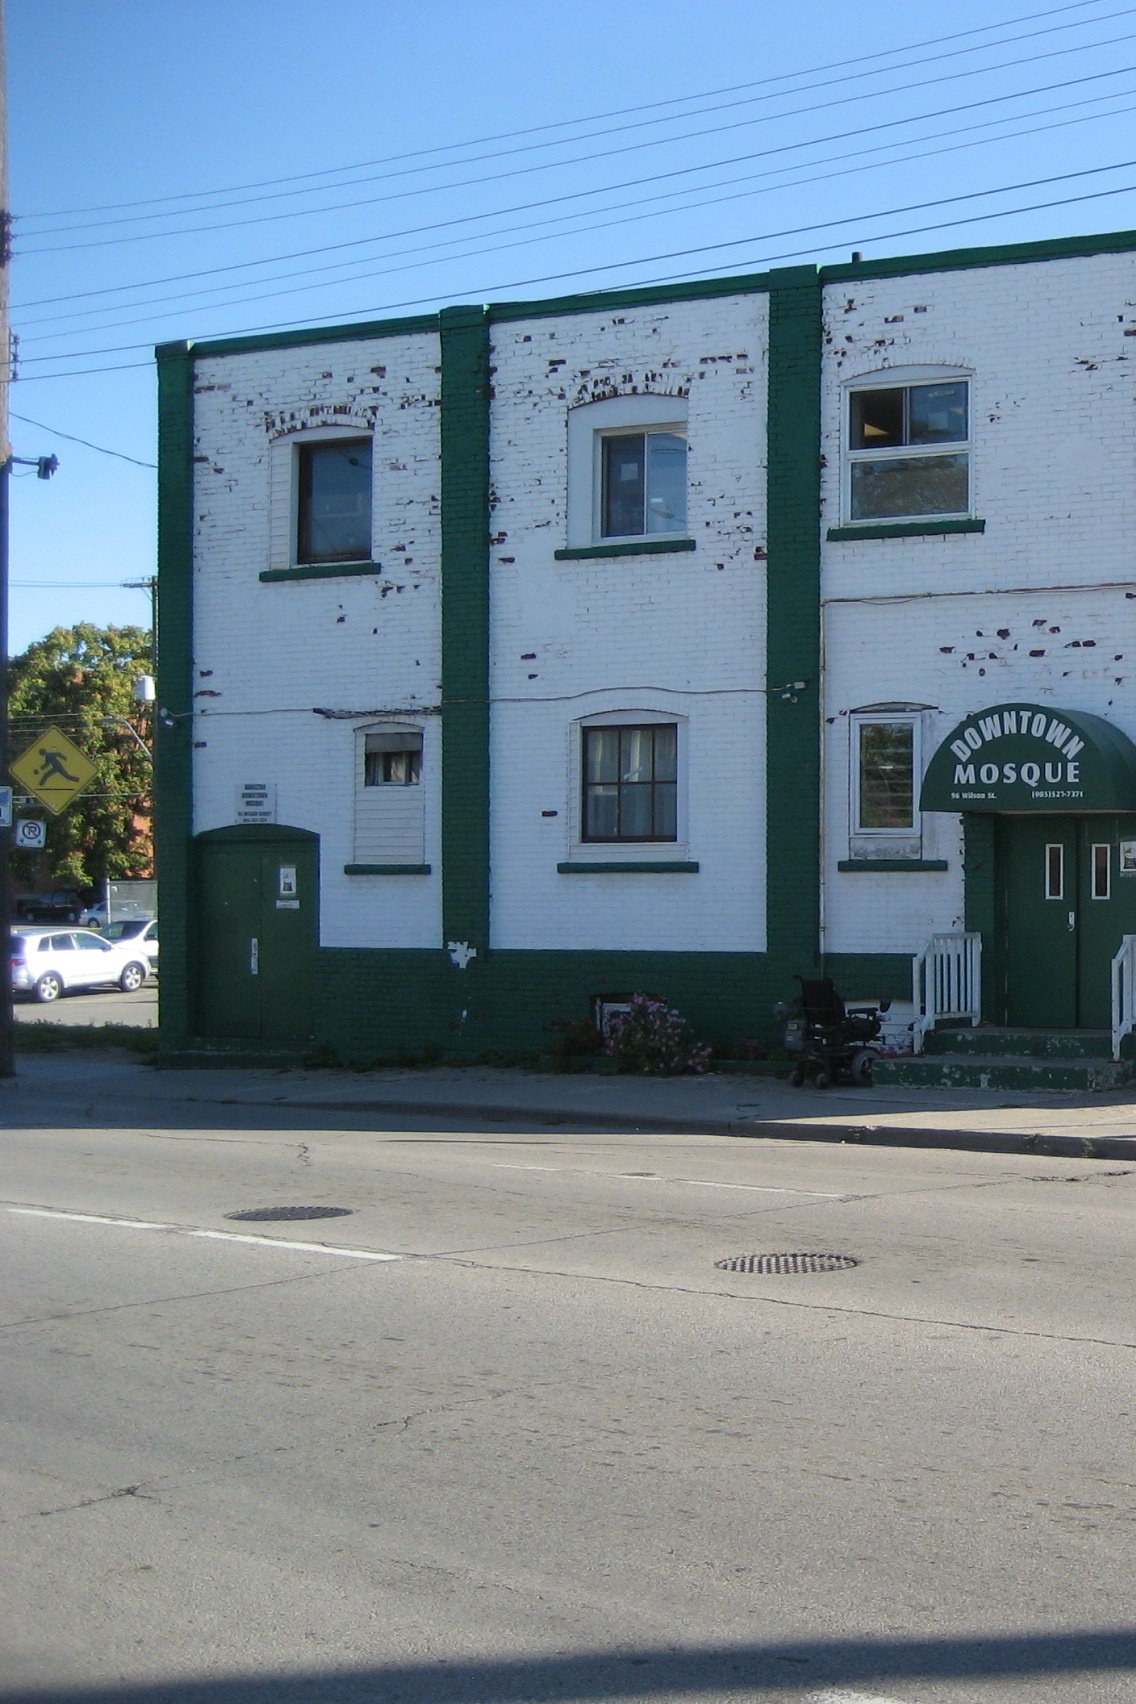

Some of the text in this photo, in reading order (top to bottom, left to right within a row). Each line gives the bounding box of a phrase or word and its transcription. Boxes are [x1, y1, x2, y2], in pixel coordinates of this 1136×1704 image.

[950, 711, 1085, 762] DOWNTOWN
[954, 762, 1080, 787] MOSQUE
[962, 791, 986, 799] Wilson
